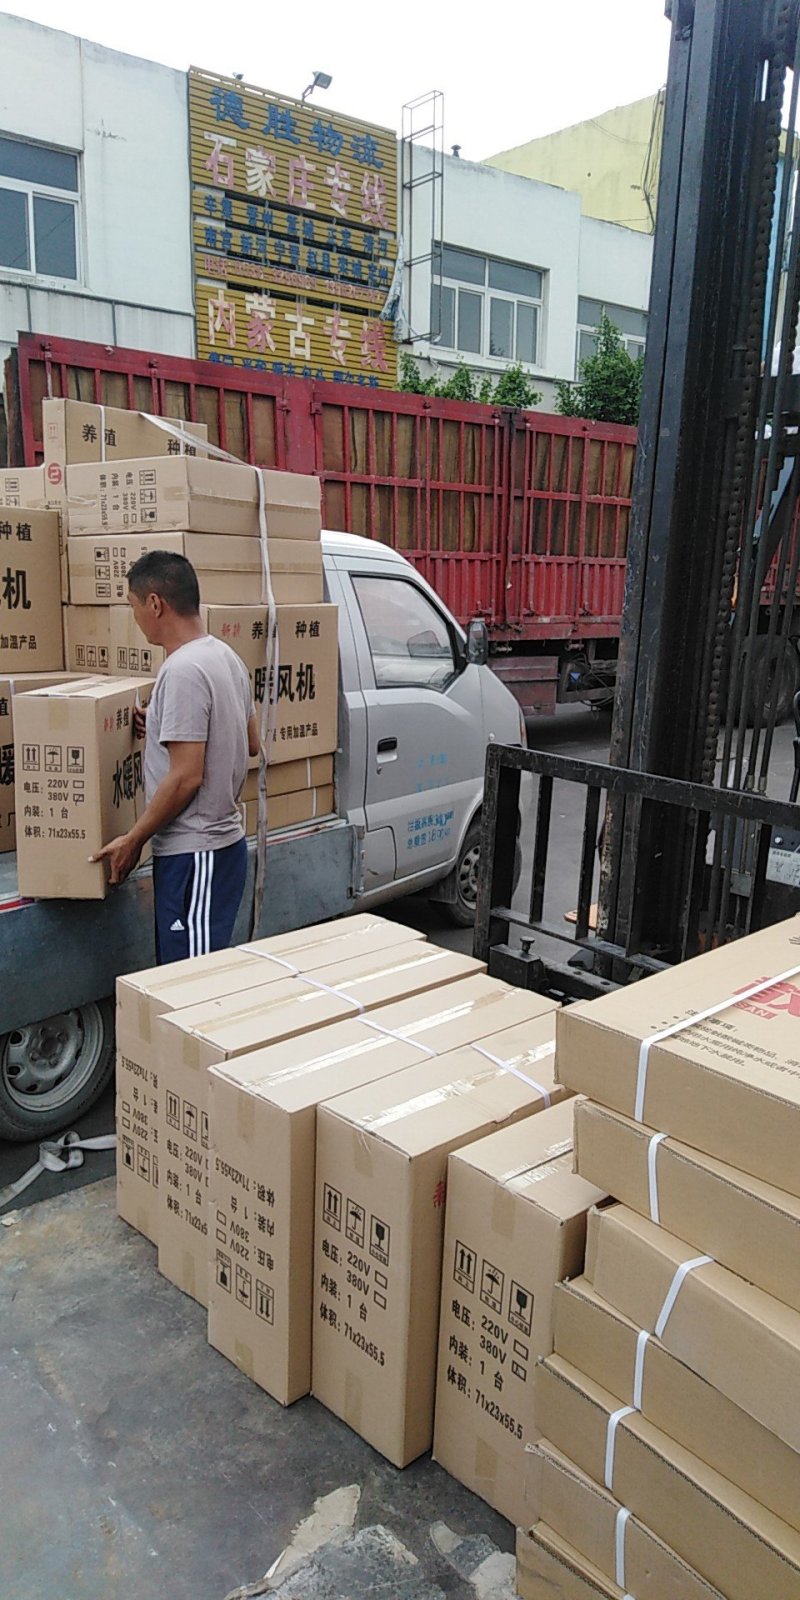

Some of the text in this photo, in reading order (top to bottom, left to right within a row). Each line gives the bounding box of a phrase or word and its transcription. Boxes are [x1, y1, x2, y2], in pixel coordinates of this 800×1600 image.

[208, 86, 384, 170] 德胜物流
[203, 130, 390, 229] 石家庄专线
[208, 289, 389, 372] 内蒙古专线
[295, 621, 320, 638] 种植
[23, 779, 69, 794] 电压： 220V
[47, 792, 69, 802] 380V
[24, 805, 69, 819] 内装： 1 台
[24, 825, 86, 840] 体积： 71x23x55.5
[132, 1107, 148, 1126] 380V
[132, 1122, 148, 1142] 220V
[167, 1139, 182, 1161] 电压：
[185, 1145, 203, 1166] 220V
[184, 1162, 202, 1183] 380V
[215, 1156, 275, 1208] 体积： 71x23x55.5
[167, 1168, 202, 1206] 内装： 1 台
[167, 1194, 183, 1219] 体积：
[231, 1195, 275, 1238] 内装： 1 台
[230, 1220, 249, 1243] 380V
[230, 1238, 249, 1261] 220V
[253, 1246, 274, 1272] 电压：
[321, 1238, 342, 1267] 电压：
[347, 1250, 371, 1277] 220V
[346, 1269, 370, 1296] 380V
[320, 1272, 368, 1322] 内装： 1 台
[319, 1301, 386, 1368] 体积： 71x23x55.5
[451, 1298, 476, 1331] 电压：
[481, 1314, 509, 1345] 220V
[479, 1334, 507, 1365] 380V
[449, 1334, 504, 1393] 内装： 1 台
[446, 1363, 524, 1441] 体积： 71x23x55.5
